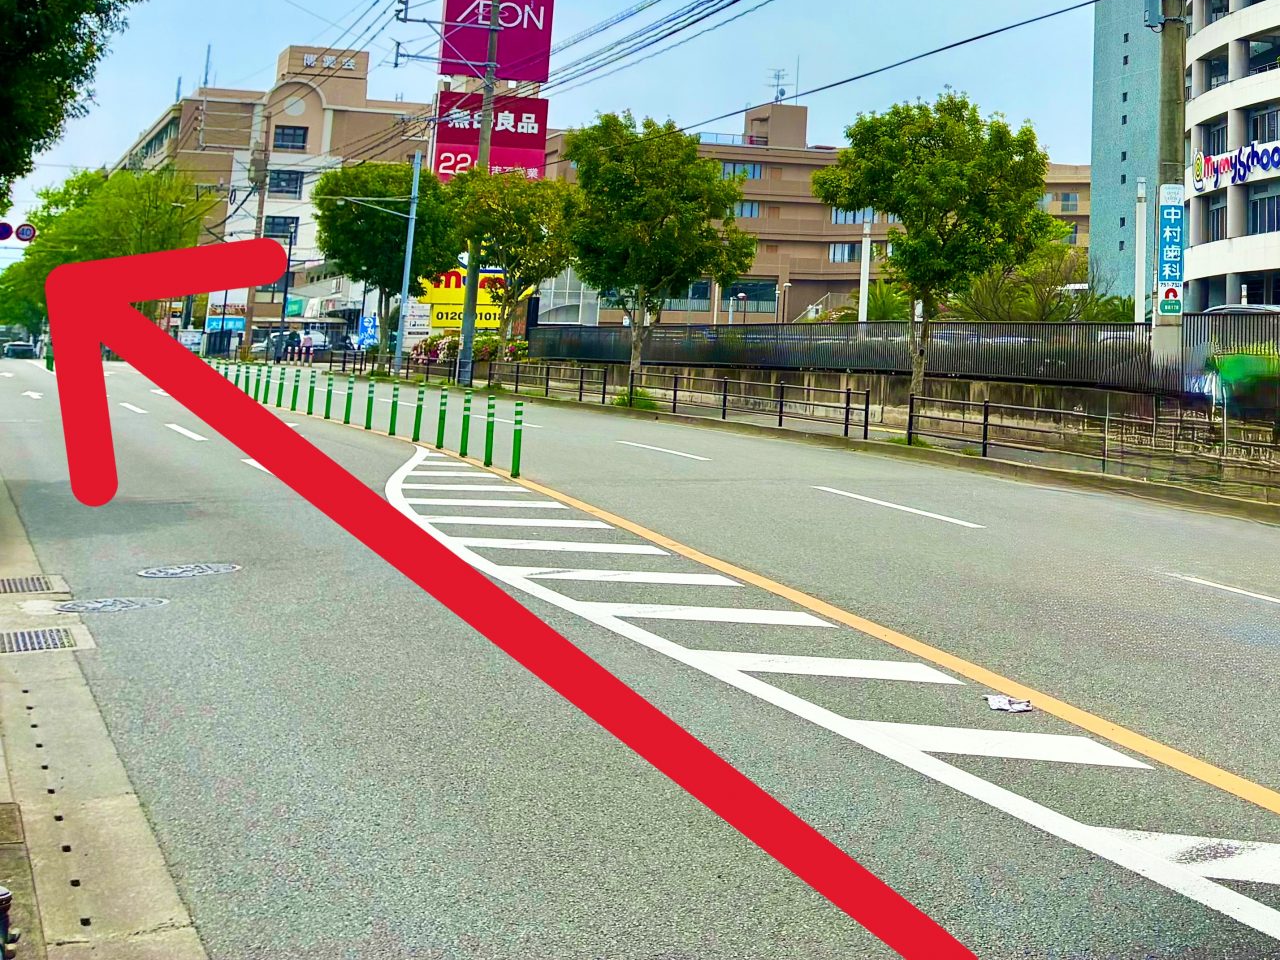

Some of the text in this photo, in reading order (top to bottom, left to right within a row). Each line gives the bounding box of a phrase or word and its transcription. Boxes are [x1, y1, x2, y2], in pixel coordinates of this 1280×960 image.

[20, 228, 32, 237] 40
[1162, 206, 1182, 281] 中村歯科
